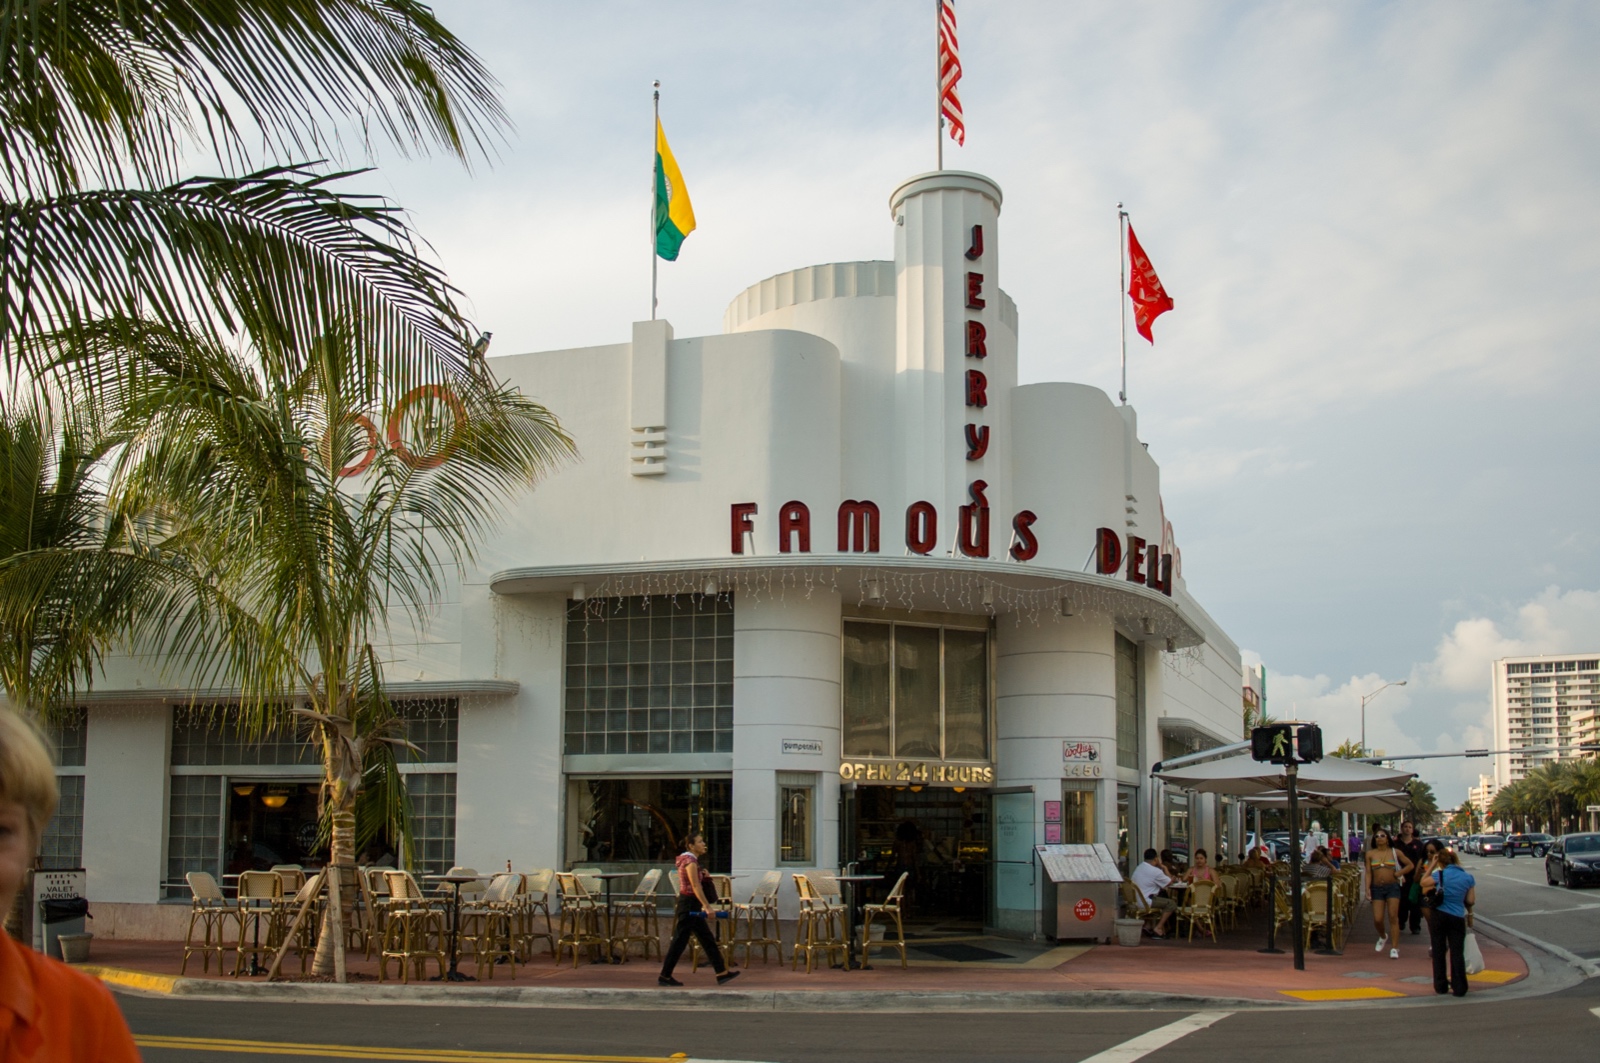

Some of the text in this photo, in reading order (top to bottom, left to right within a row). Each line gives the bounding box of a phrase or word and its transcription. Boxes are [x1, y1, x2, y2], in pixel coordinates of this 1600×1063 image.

[730, 500, 1172, 597] FAMOUS DELI
[839, 762, 994, 783] OPEN 24 HOURS
[1063, 764, 1102, 777] 1450
